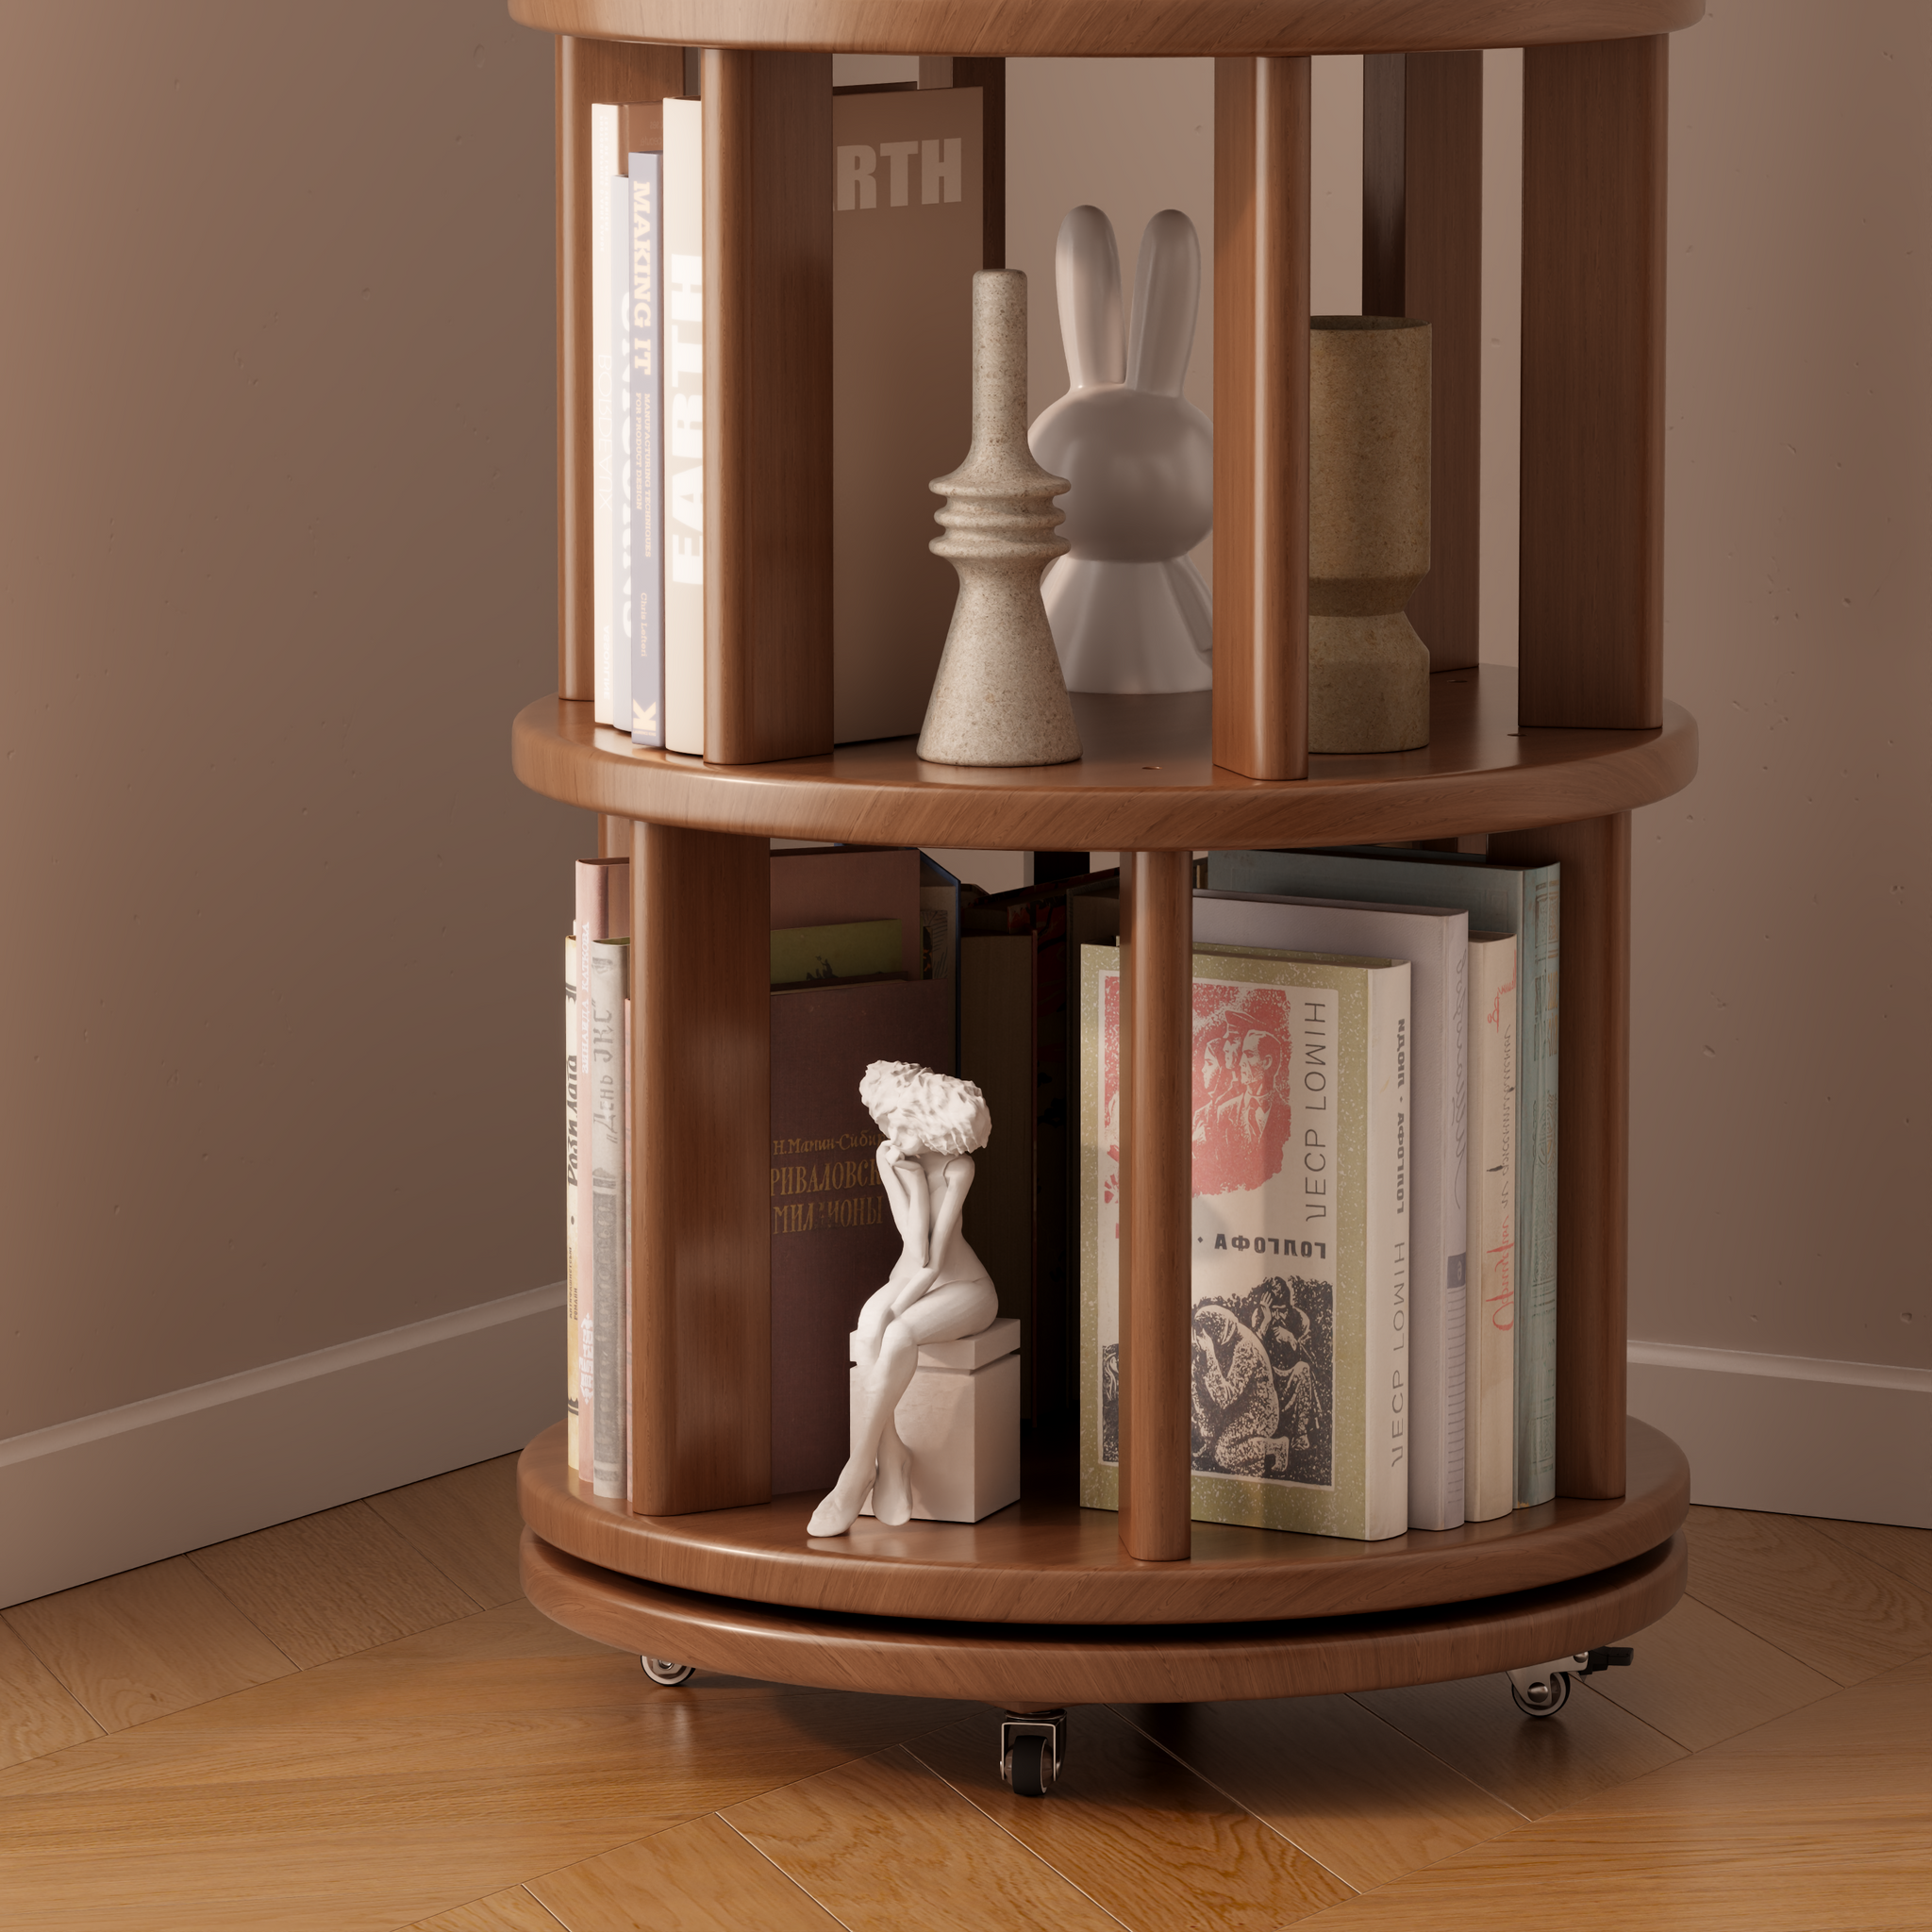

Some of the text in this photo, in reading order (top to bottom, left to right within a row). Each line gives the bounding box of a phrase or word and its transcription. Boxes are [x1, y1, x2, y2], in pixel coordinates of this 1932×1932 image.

[833, 138, 962, 212] RTH
[633, 180, 651, 375] MAKING IT
[671, 253, 703, 588] EARTH
[643, 489, 652, 558] TECHNIQUES
[640, 592, 648, 621] Chris
[580, 922, 590, 1074] ЗИНАИДА КАТКОВА
[770, 1158, 882, 1197] РИВАЛОВСК
